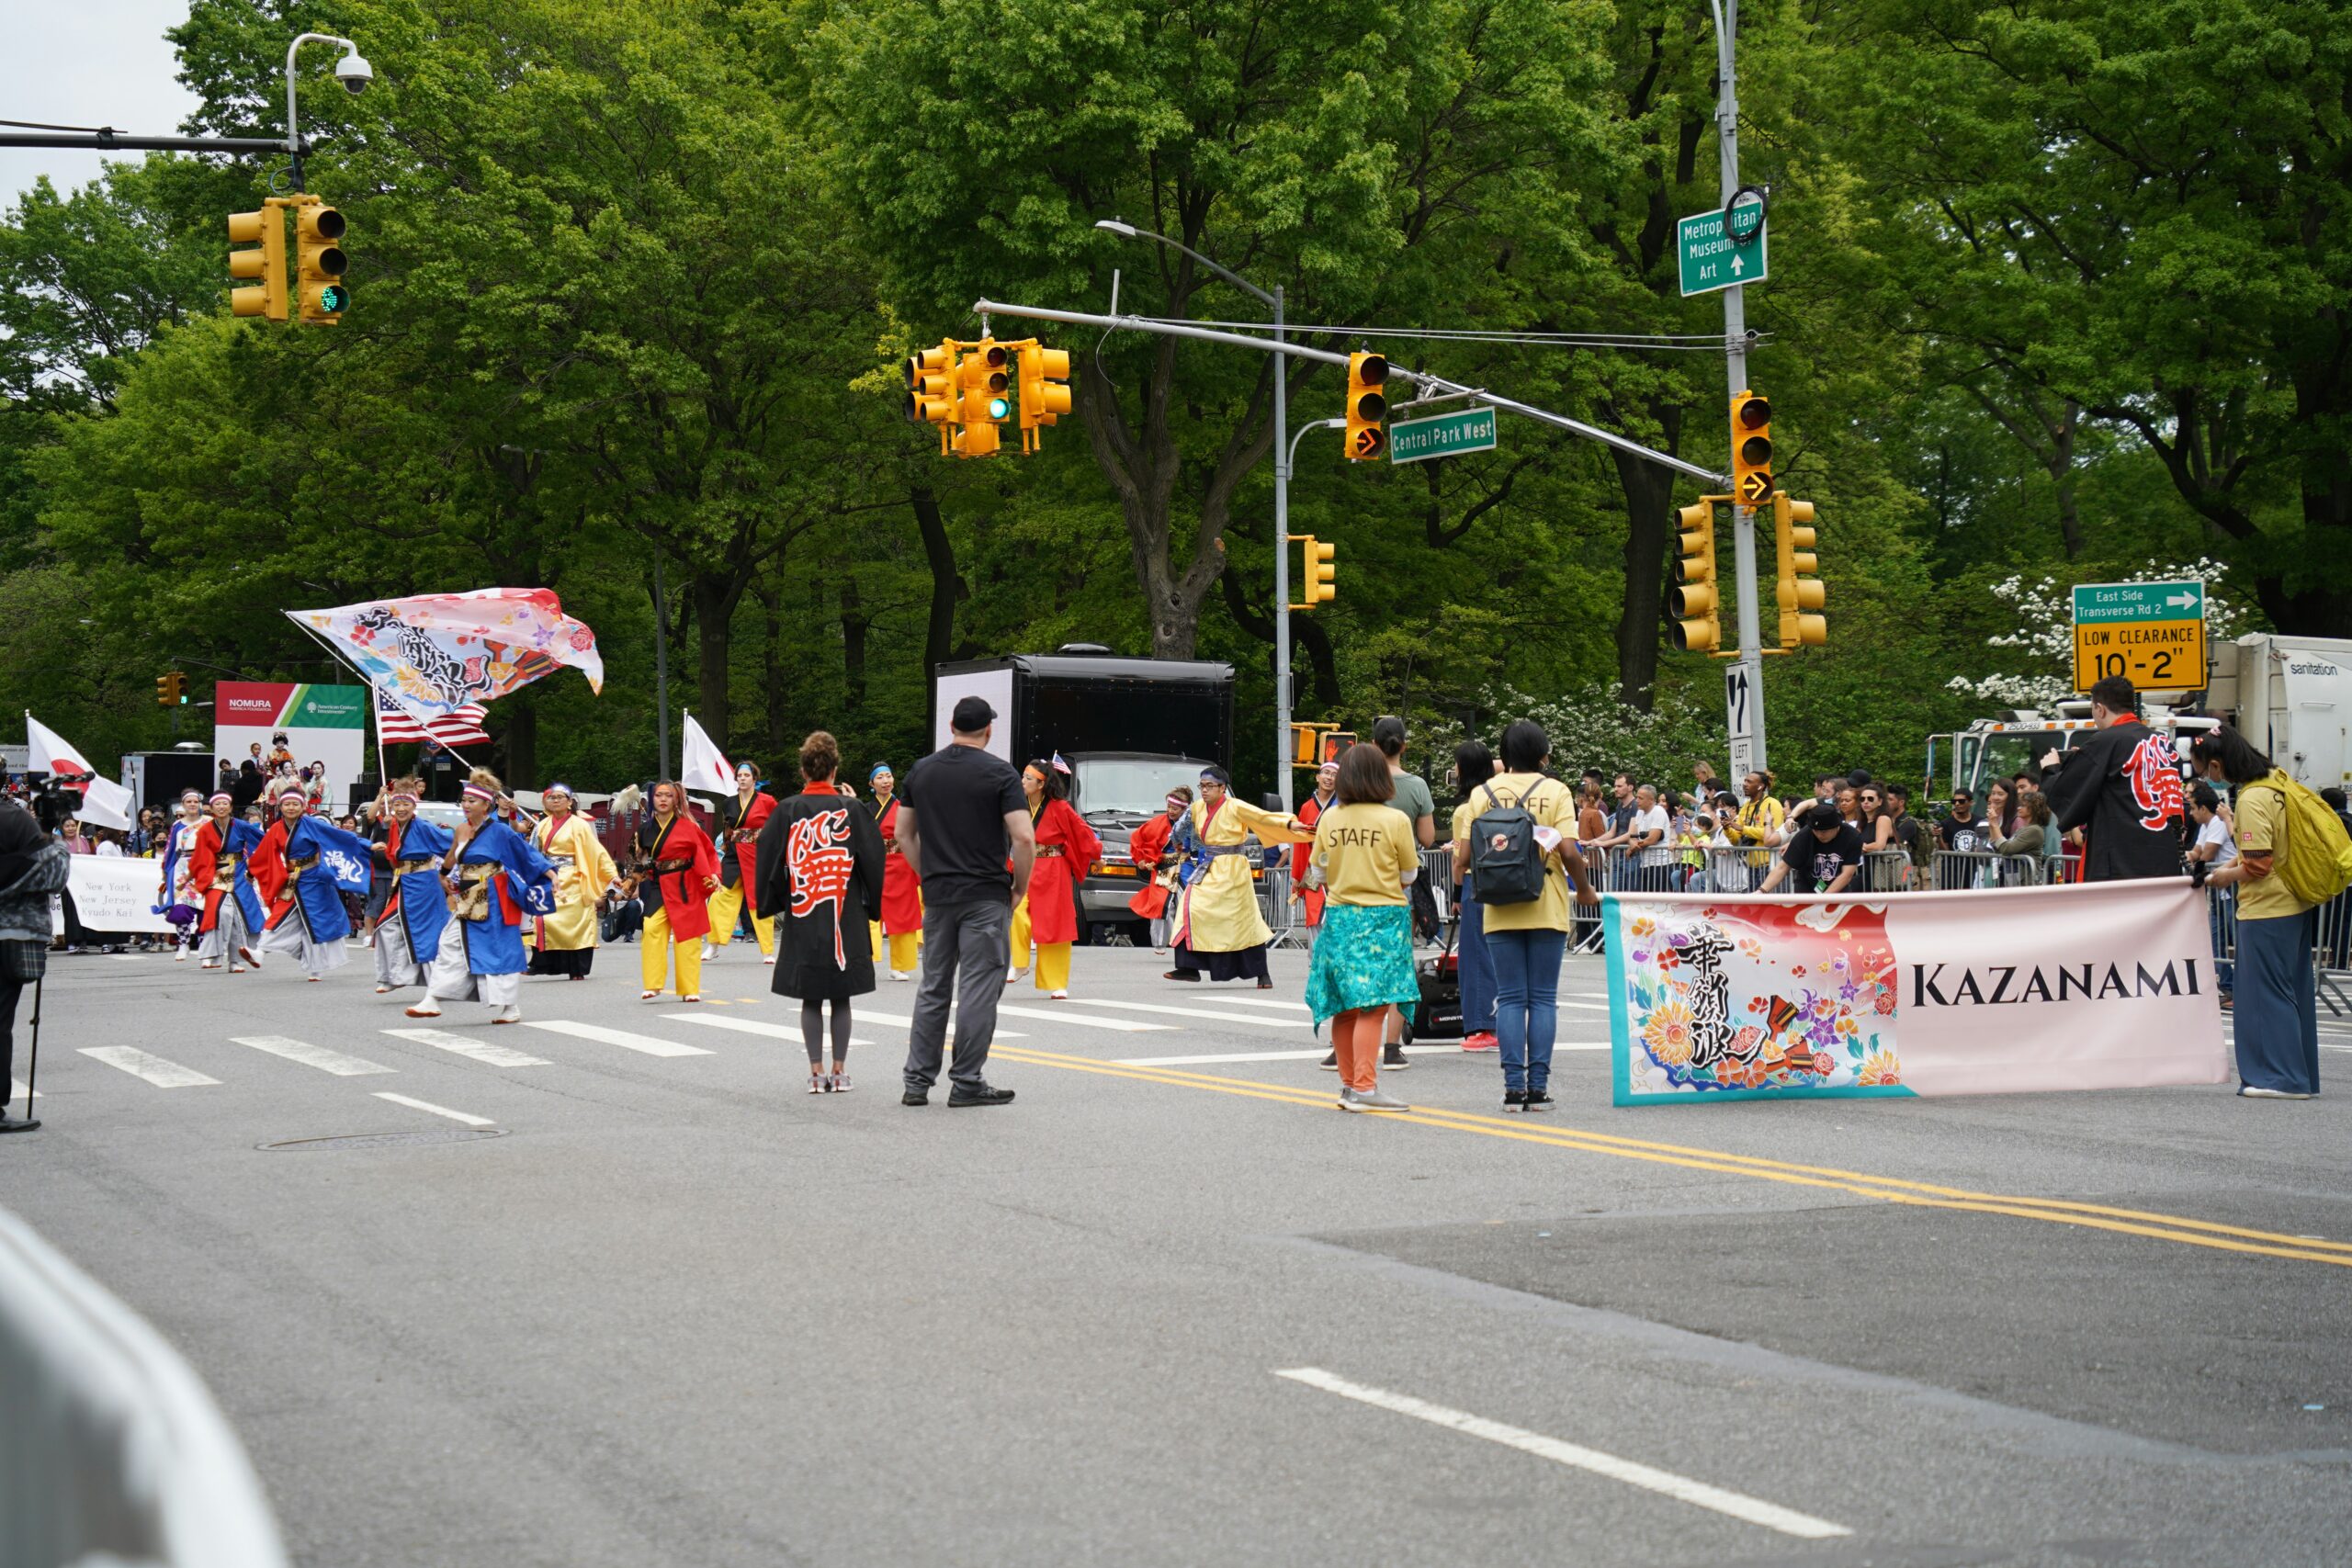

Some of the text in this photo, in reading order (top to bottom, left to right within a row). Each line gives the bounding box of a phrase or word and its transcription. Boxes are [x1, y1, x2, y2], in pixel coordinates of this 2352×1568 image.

[1684, 211, 1757, 241] Metropitan
[1690, 237, 1735, 259] Museum
[1700, 263, 1717, 280] Art
[1393, 420, 1492, 452] Central Park West
[2097, 591, 2143, 603] East Side
[2077, 604, 2162, 617] Transverse Rd 2
[2085, 628, 2194, 646] LOW CLEARANCE
[2290, 661, 2338, 676] sanitation
[229, 699, 272, 708] NOMURA
[1735, 744, 1748, 759] LEFT
[1735, 763, 1750, 778] TURN
[1733, 784, 1745, 797] SIG
[1329, 828, 1382, 848] STAFF
[1962, 837, 1970, 851] B
[85, 883, 131, 892] New York
[79, 895, 137, 906] New Jersey
[82, 908, 133, 918] Kyudo Kai
[1910, 958, 2203, 1008] KAZANAMI
